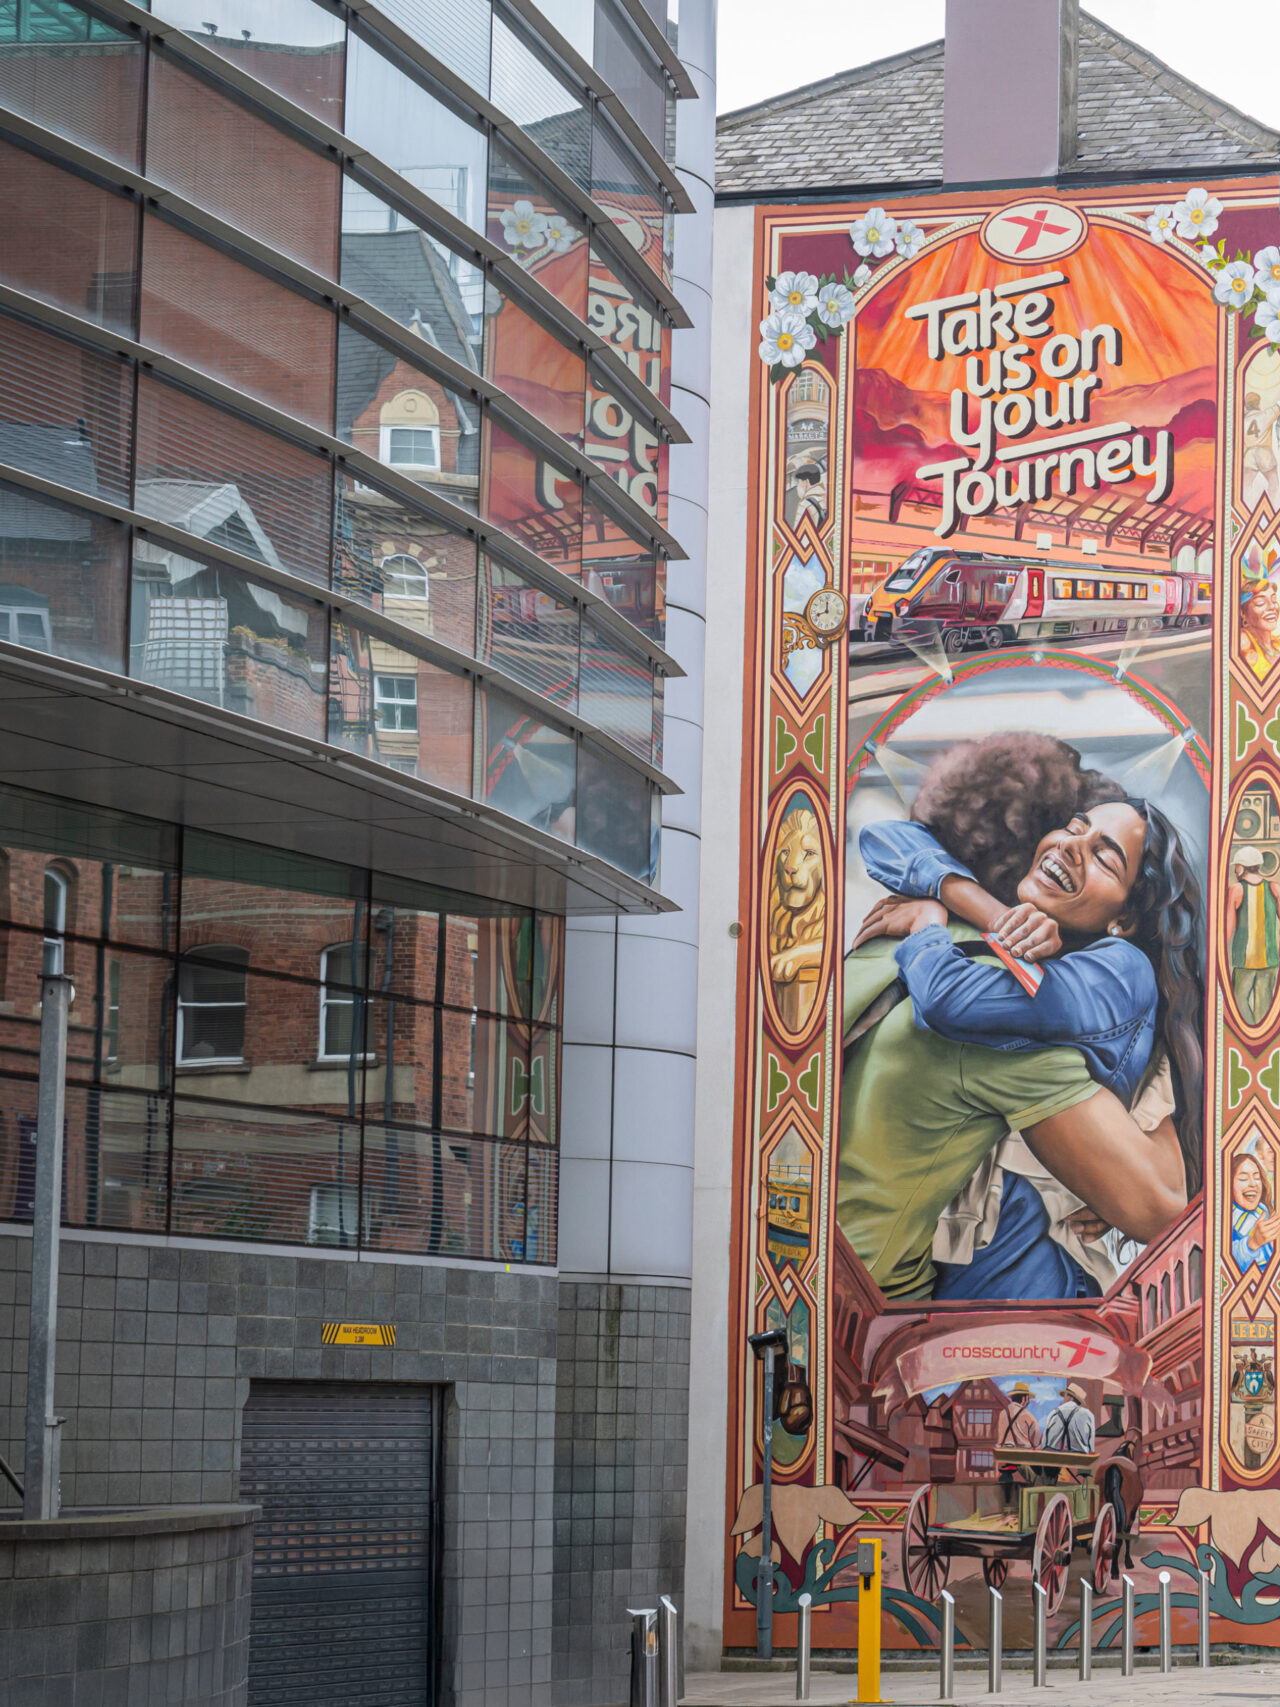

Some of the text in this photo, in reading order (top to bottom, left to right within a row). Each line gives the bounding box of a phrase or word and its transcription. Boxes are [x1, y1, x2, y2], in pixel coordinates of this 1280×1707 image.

[905, 271, 1067, 361] Take
[966, 323, 1122, 397] us on
[950, 374, 1102, 473] your
[1246, 418, 1261, 438] 4
[915, 422, 1174, 538] Journey
[942, 1345, 1061, 1362] crosscountry
[1231, 1322, 1275, 1339] LEEDS
